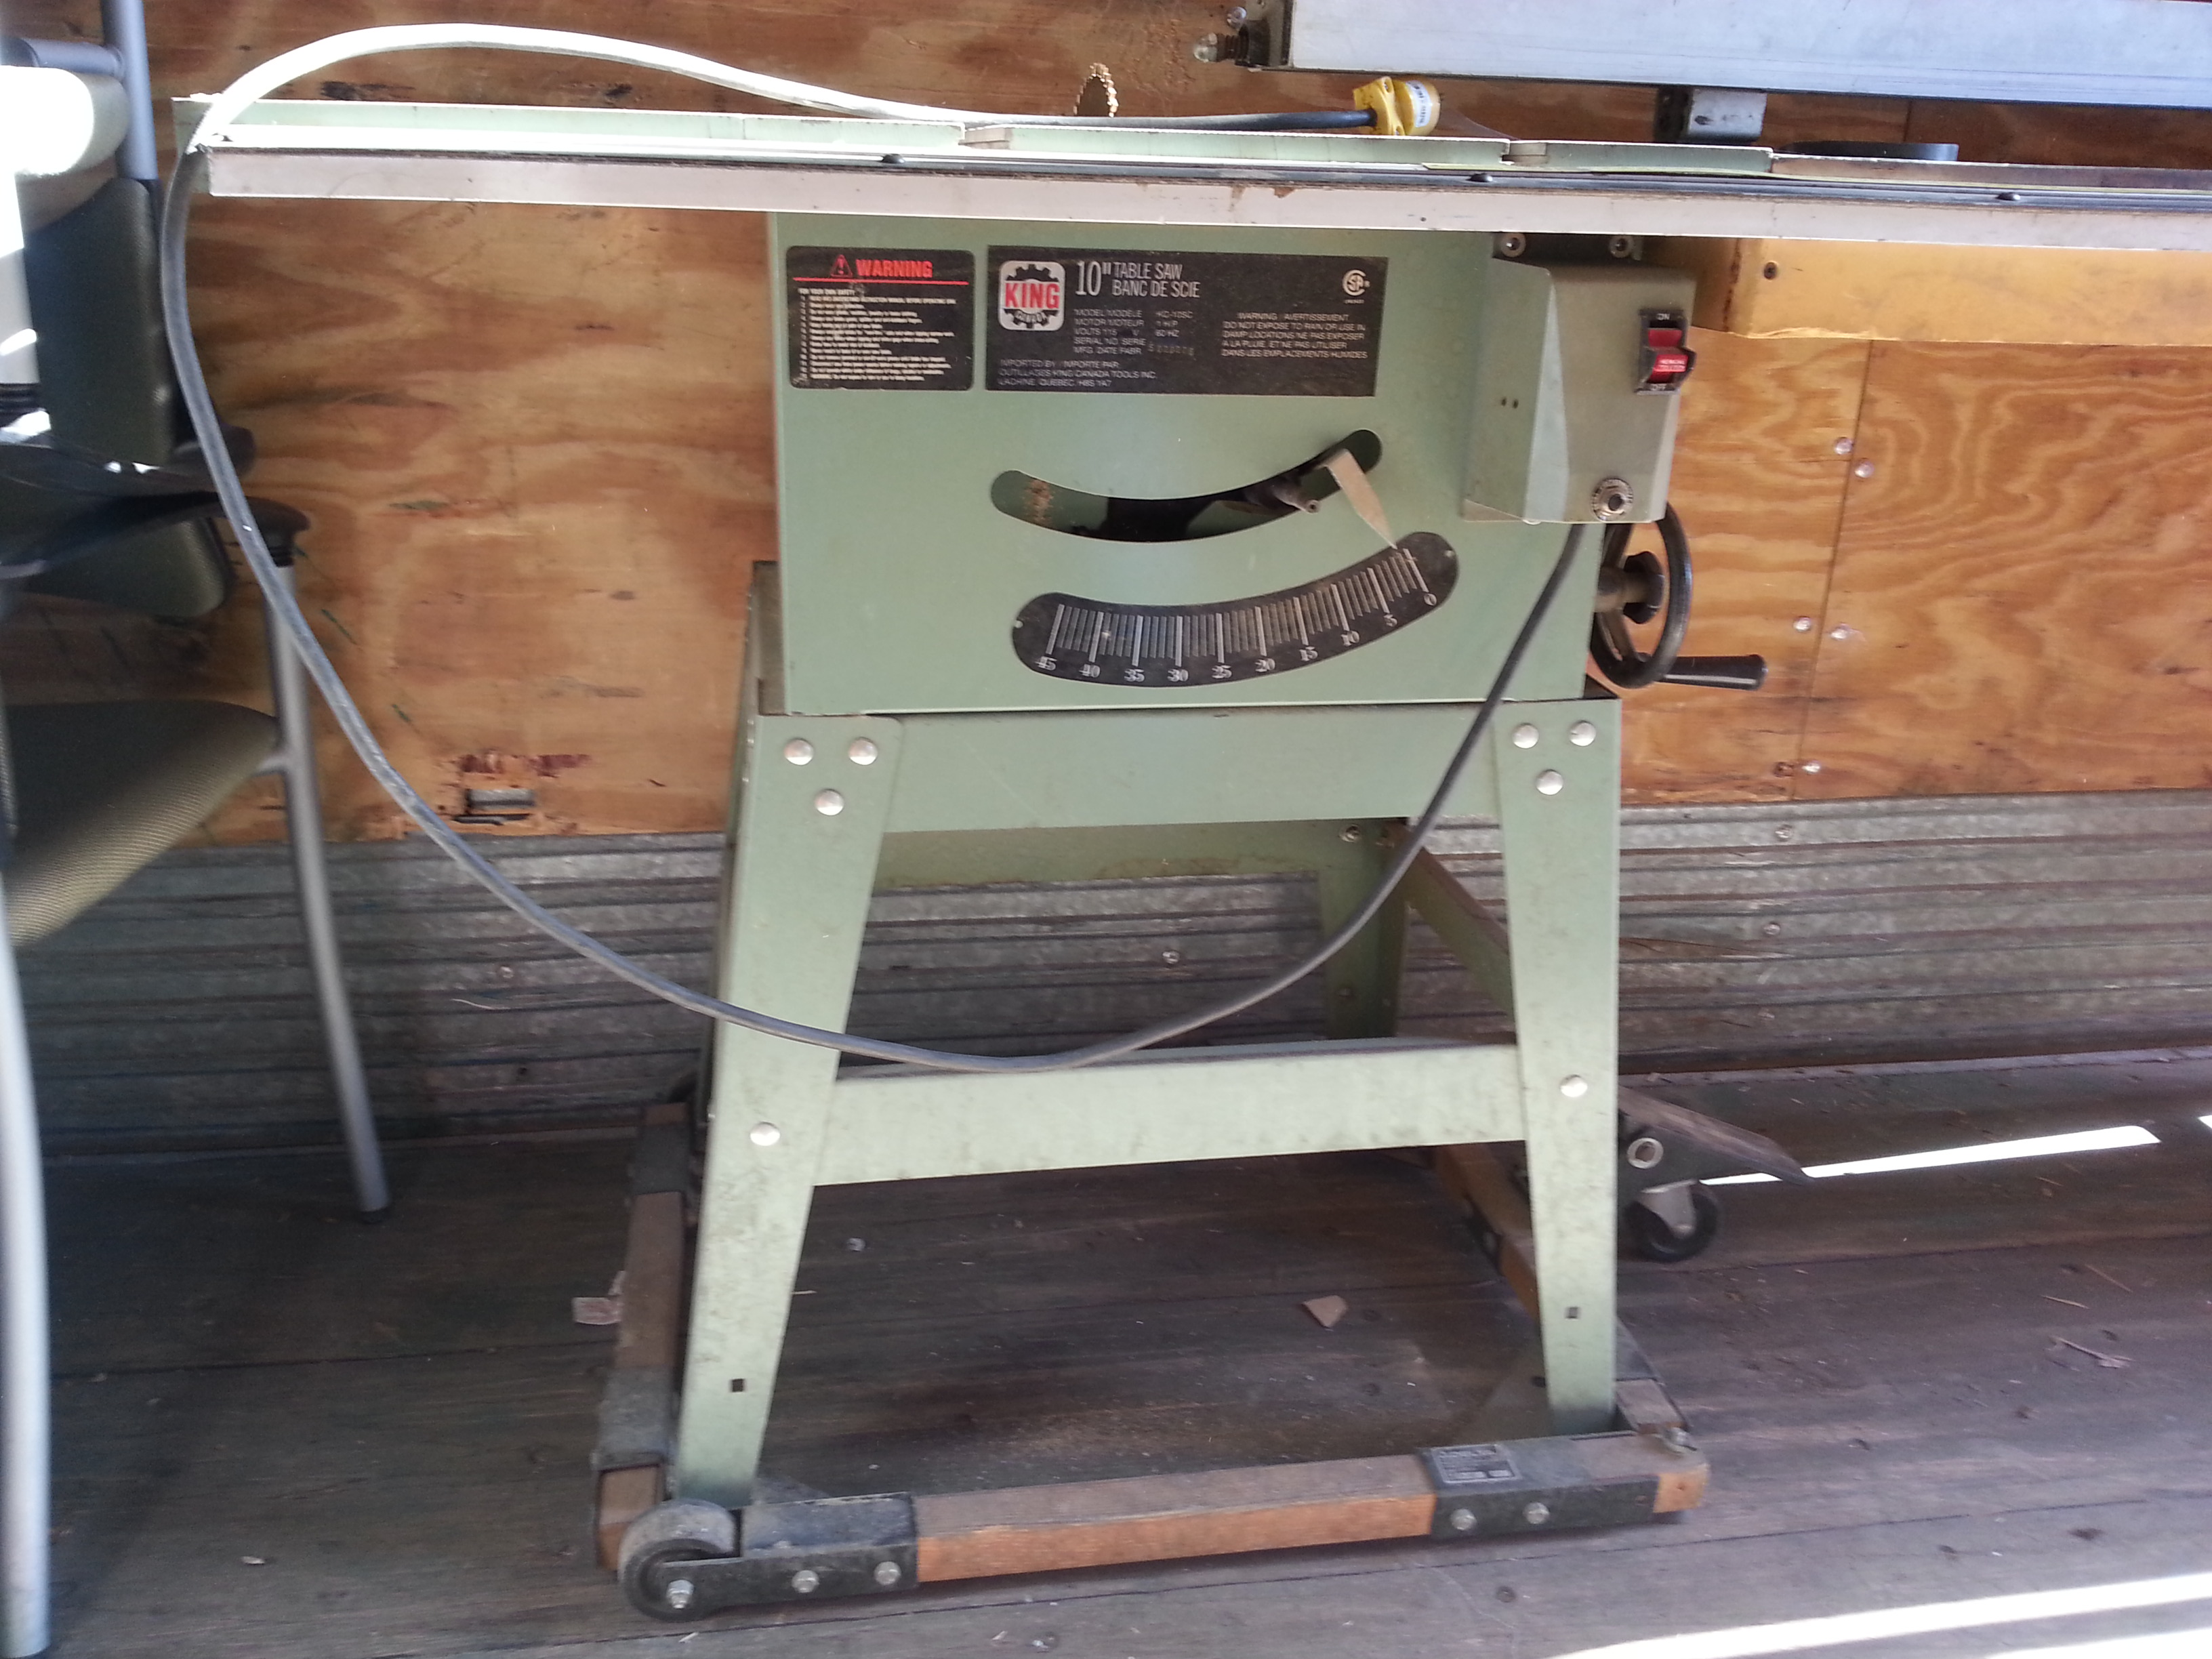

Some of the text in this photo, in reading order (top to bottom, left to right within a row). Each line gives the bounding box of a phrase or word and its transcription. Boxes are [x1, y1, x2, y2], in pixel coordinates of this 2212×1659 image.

[855, 259, 933, 278] WARNING
[1113, 262, 1183, 280] TABLE SAW
[1005, 283, 1060, 309] KING
[1112, 279, 1201, 299] BANC DE SCIE
[1223, 321, 1237, 329] DO
[1237, 321, 1255, 329] NOT
[1256, 321, 1290, 330] EXPOSE
[1423, 593, 1437, 606] 0
[1384, 614, 1397, 627] 5
[1340, 630, 1360, 647] 10
[1299, 646, 1318, 661] 15
[1035, 655, 1057, 671] 45
[1079, 663, 1101, 678] 40
[1255, 658, 1275, 673] 20
[1124, 668, 1145, 682] 35
[1166, 668, 1189, 682] 30
[1212, 664, 1232, 679] 25
